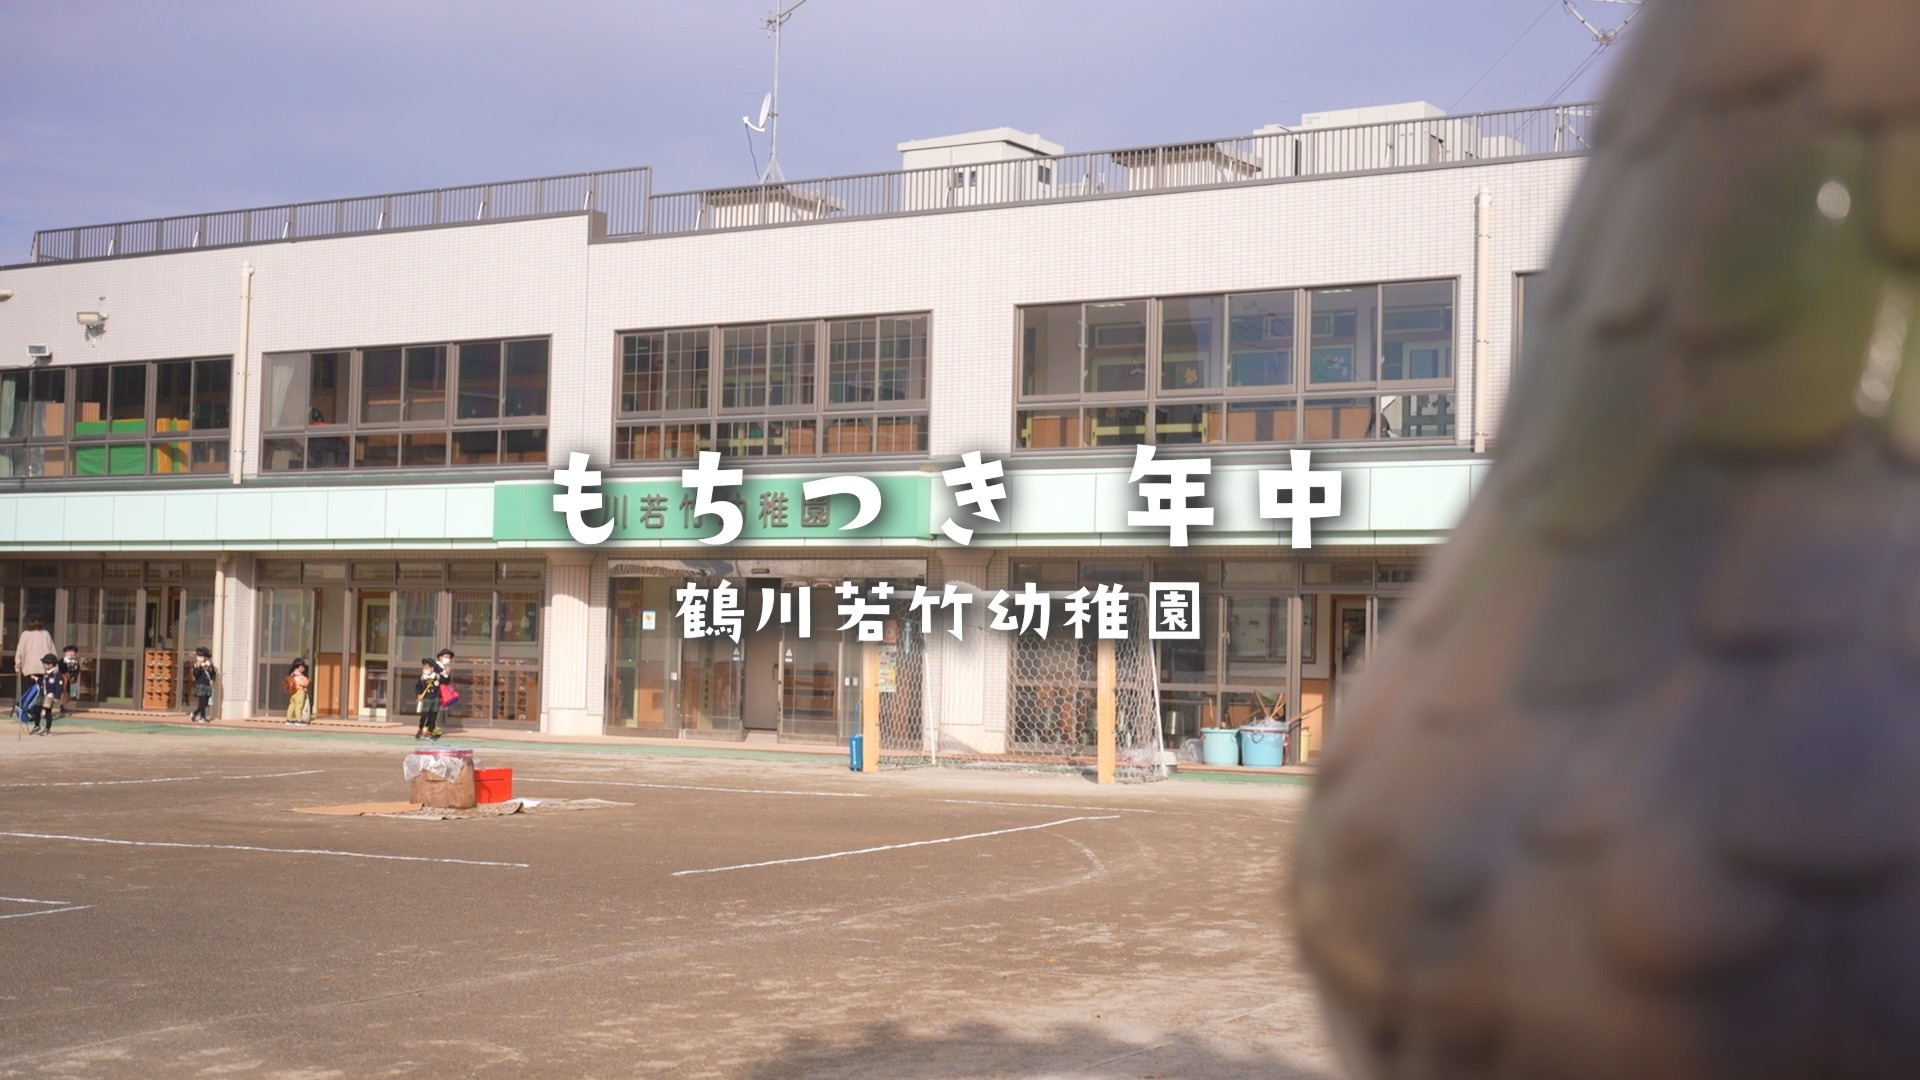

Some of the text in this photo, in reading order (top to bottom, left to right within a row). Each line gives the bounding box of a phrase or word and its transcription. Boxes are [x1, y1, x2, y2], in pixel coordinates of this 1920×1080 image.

[566, 490, 832, 530] 川若竹稚園
